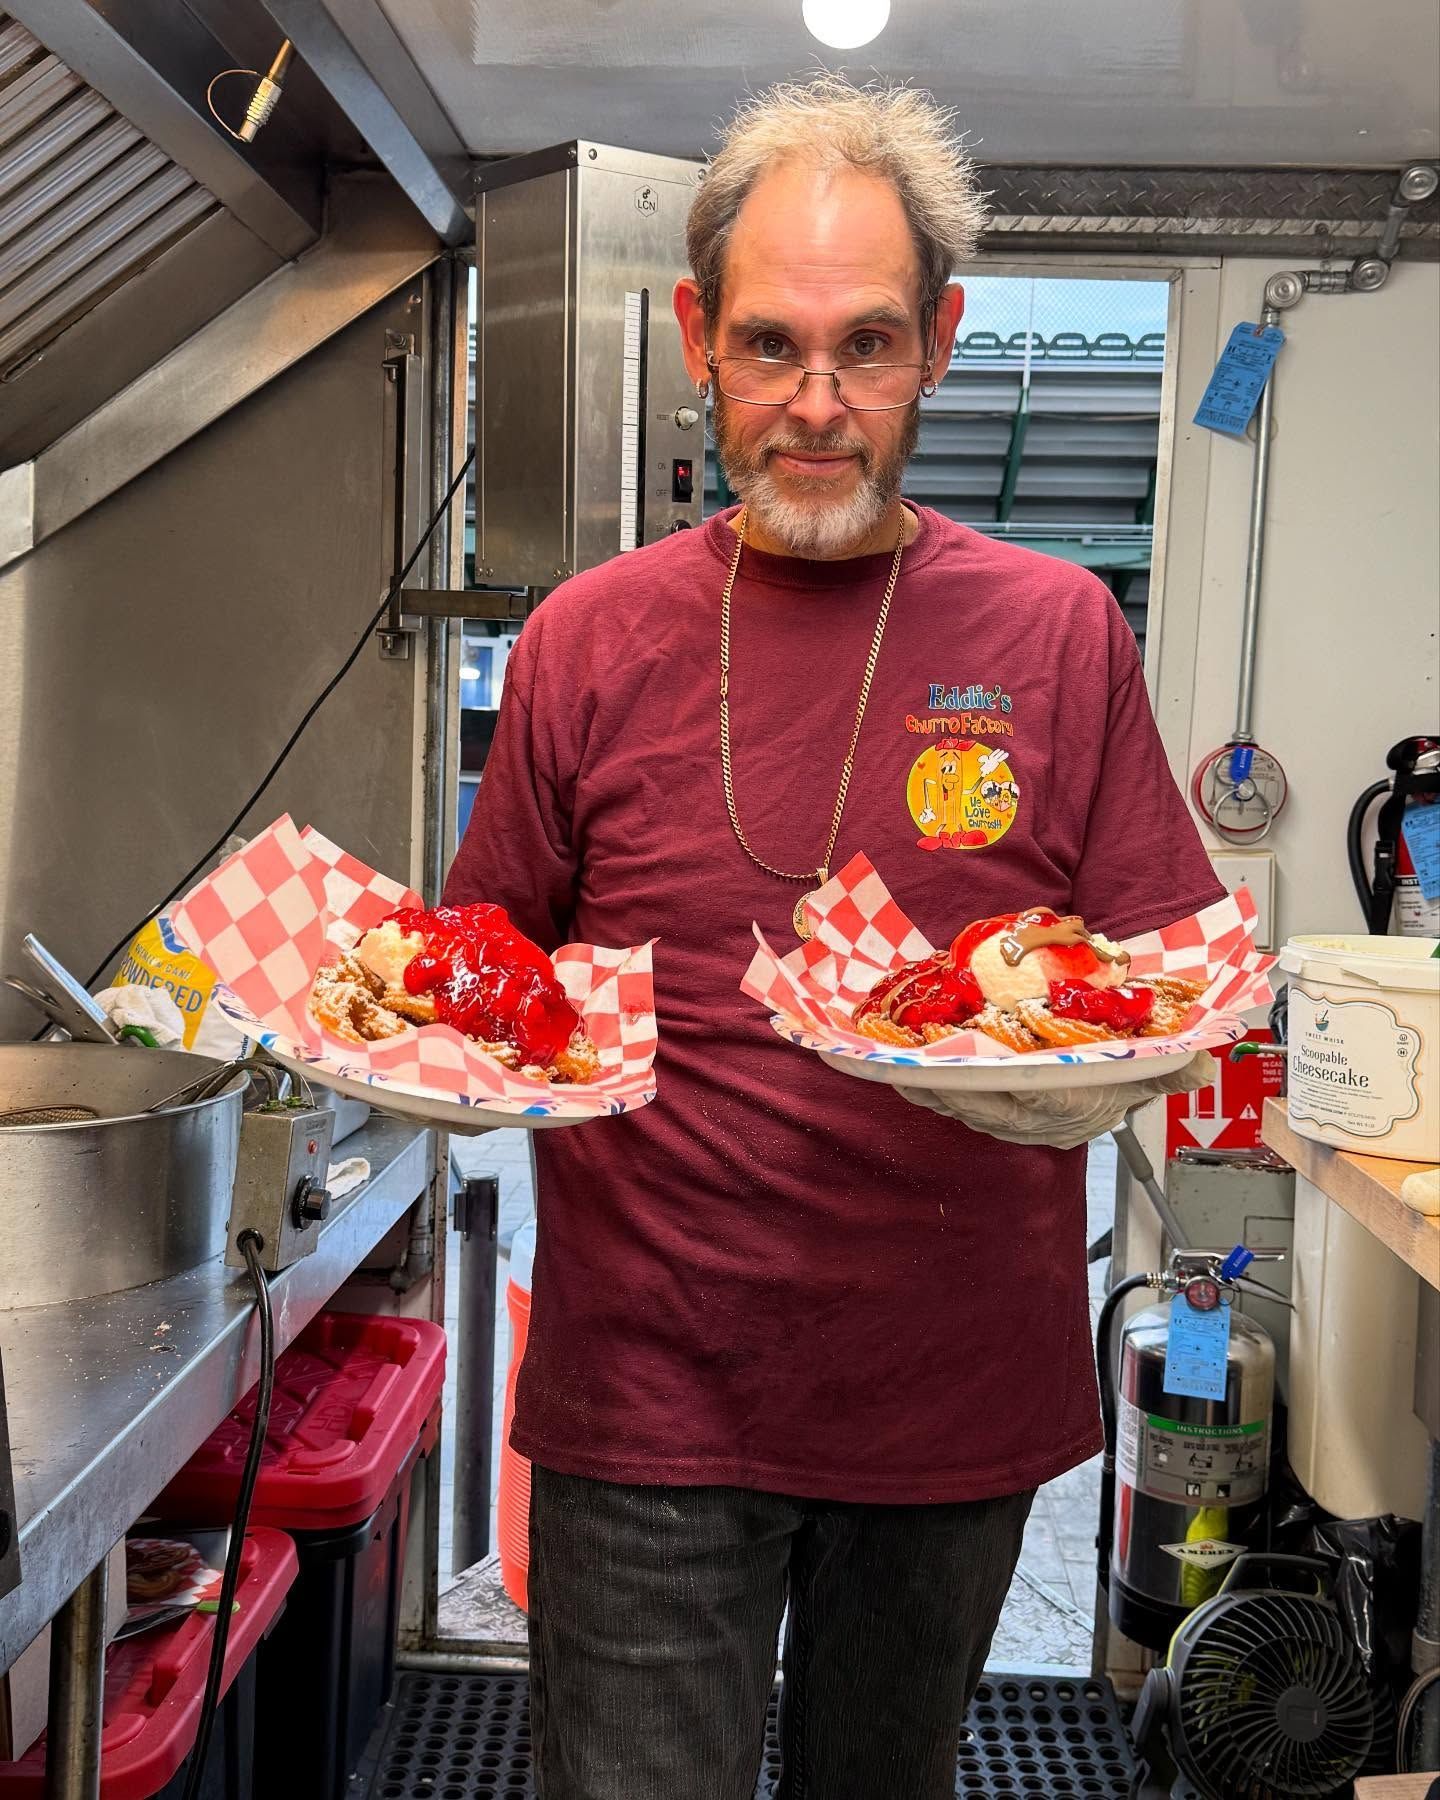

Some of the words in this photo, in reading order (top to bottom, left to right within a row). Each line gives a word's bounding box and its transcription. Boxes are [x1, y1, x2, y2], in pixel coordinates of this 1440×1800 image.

[637, 199, 656, 211] LCN
[928, 684, 1013, 713] Eddie's
[1300, 1044, 1348, 1066] Scoopable
[1292, 1054, 1369, 1088] Cheesecake
[1176, 1424, 1244, 1435] INSTRUCTIONS
